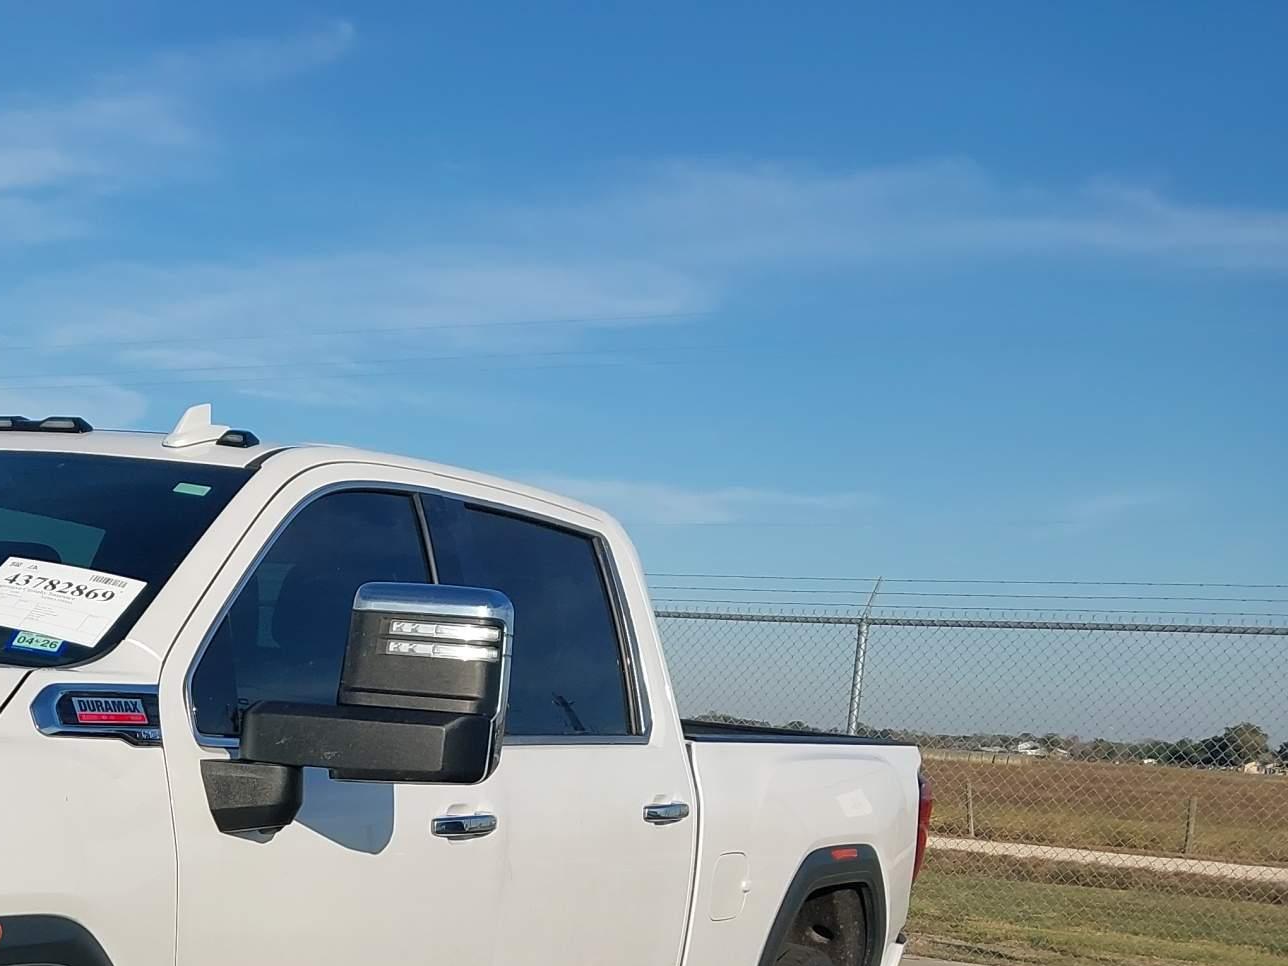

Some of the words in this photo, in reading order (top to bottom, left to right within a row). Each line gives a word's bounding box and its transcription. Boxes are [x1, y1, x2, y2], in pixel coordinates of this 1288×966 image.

[4, 572, 116, 602] 43782869
[16, 635, 34, 645] 04
[39, 638, 59, 649] 26
[77, 699, 141, 713] DURAMAX
